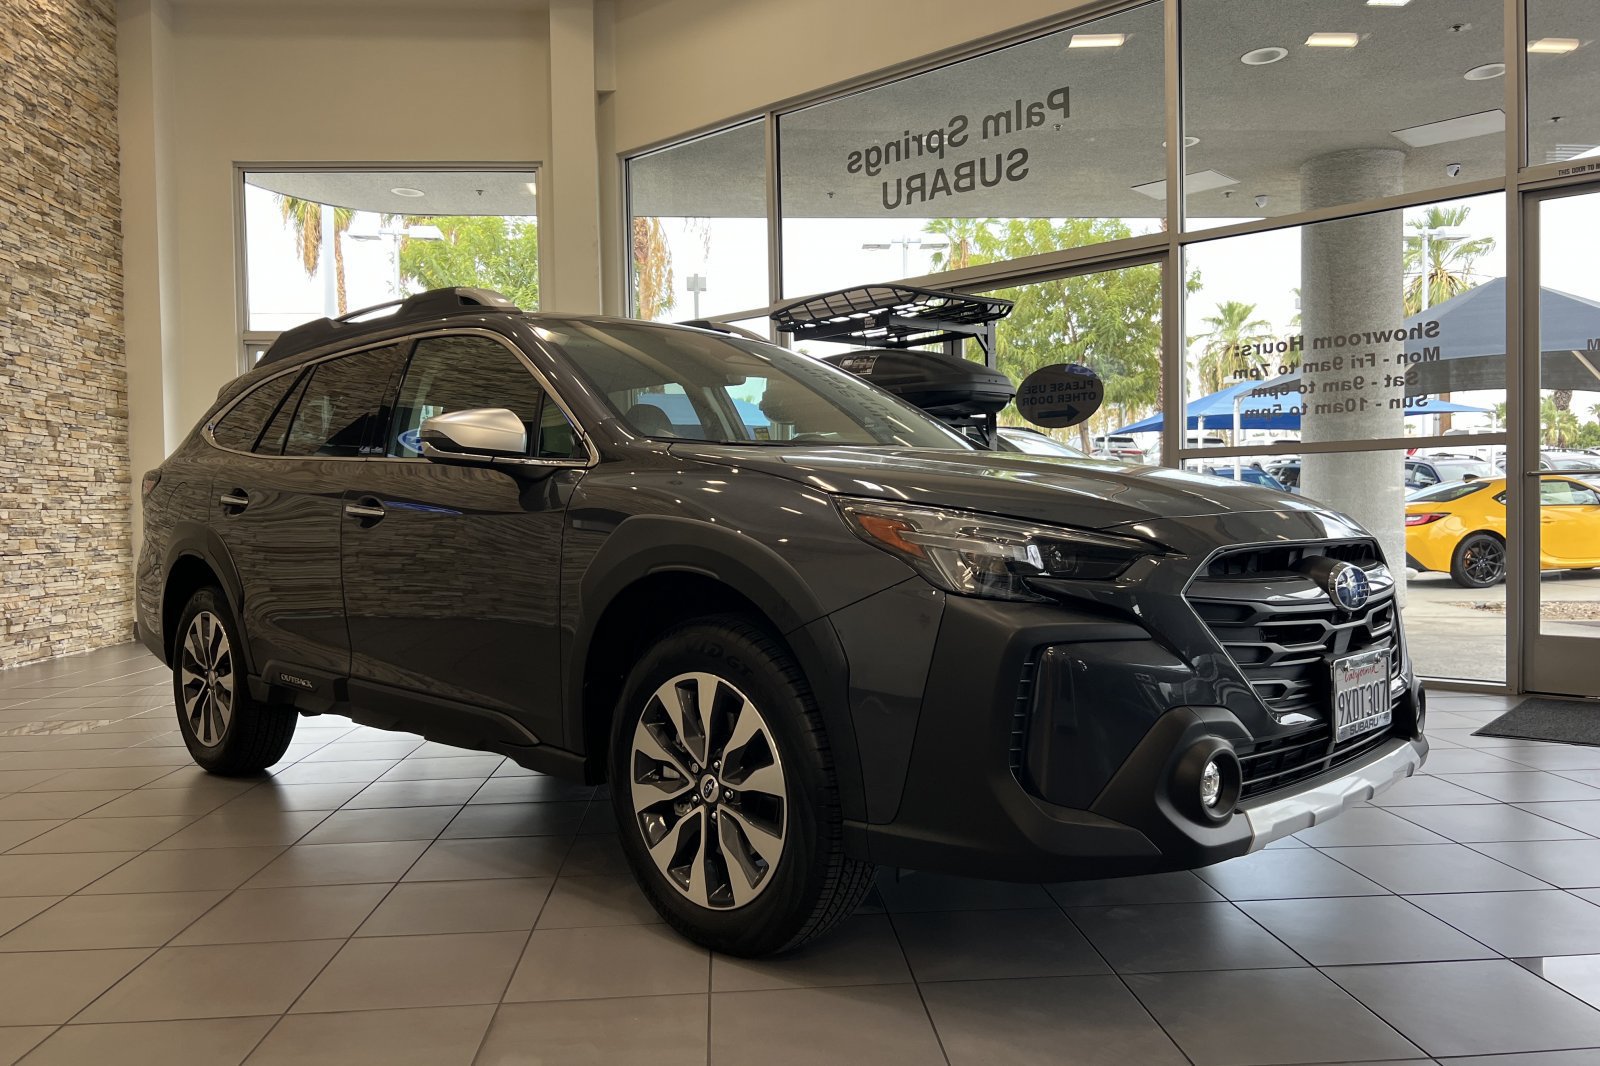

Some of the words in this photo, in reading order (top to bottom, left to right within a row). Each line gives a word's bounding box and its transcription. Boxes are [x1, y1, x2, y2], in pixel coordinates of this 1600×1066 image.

[1558, 168, 1570, 176] THIS
[280, 673, 313, 689] OUTBACK
[1337, 677, 1387, 728] 9XDT307
[1349, 717, 1379, 736] SUBARU
